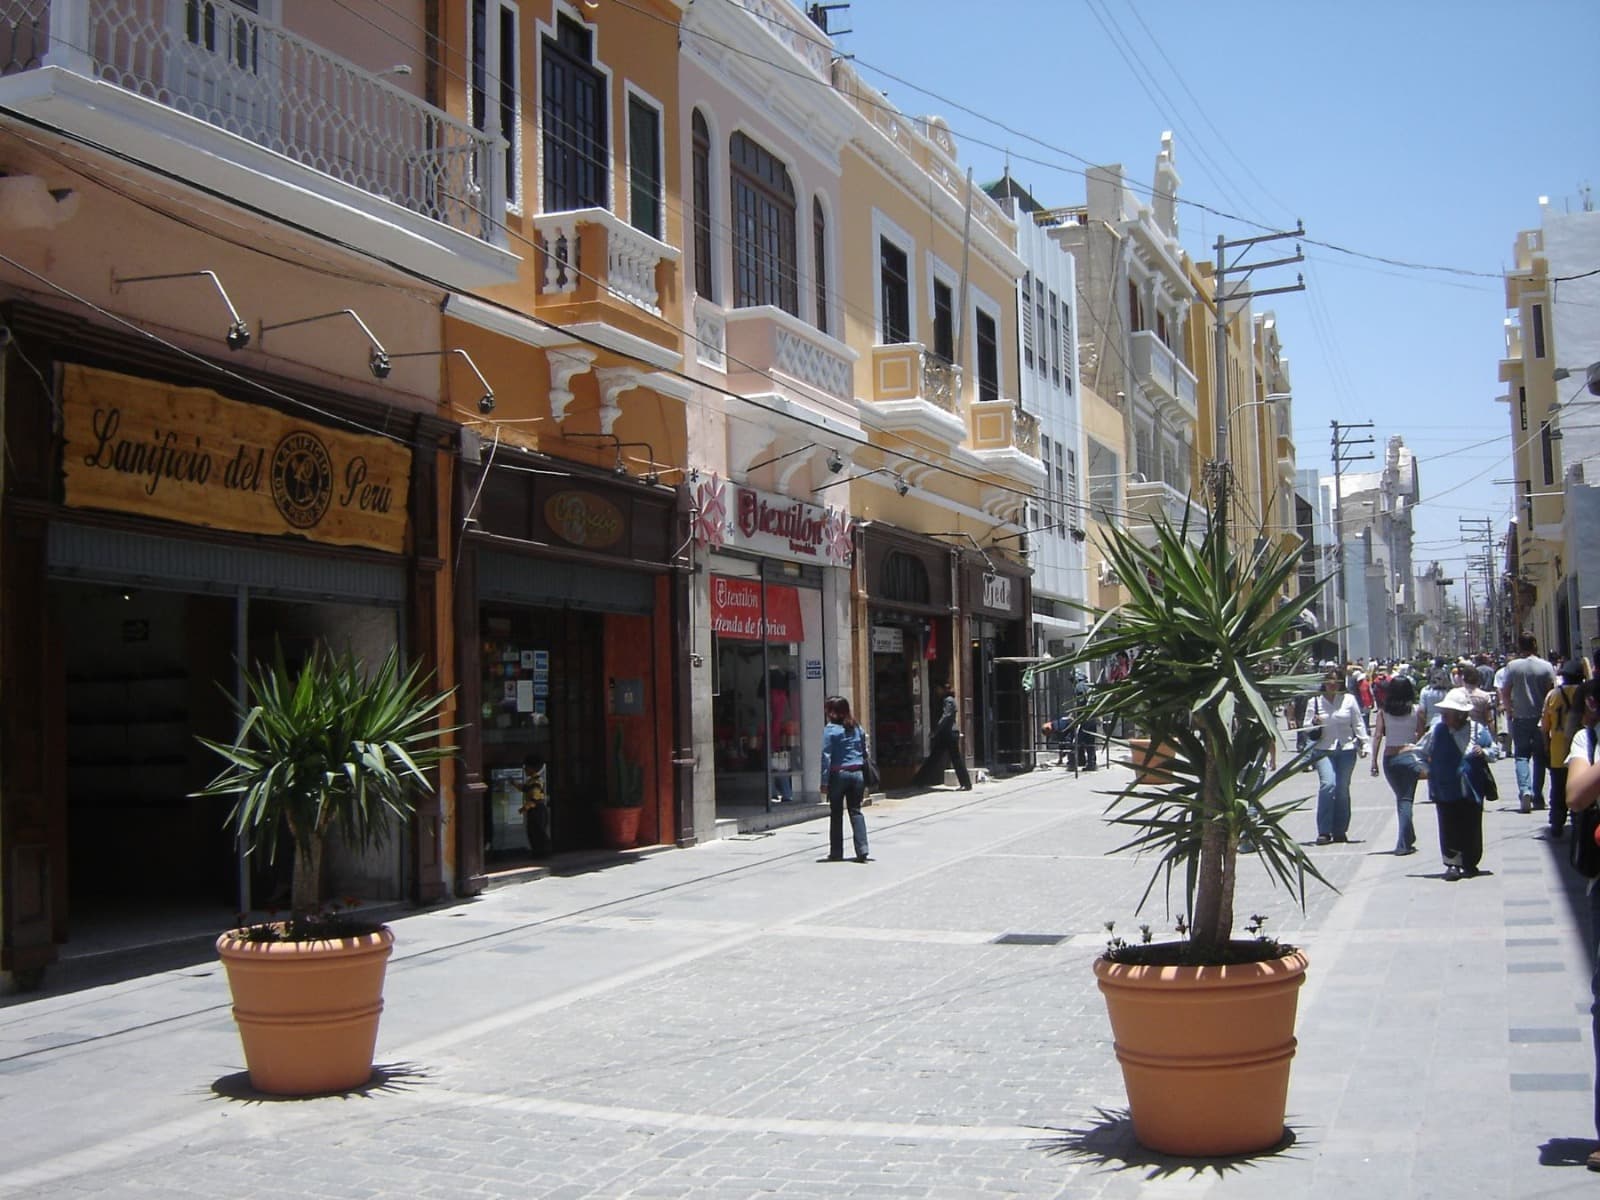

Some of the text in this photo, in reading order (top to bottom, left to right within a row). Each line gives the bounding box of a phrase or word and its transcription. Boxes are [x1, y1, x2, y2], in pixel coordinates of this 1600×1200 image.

[84, 408, 393, 513] Lanificio del Perú
[715, 613, 787, 639] tienda de fbrica
